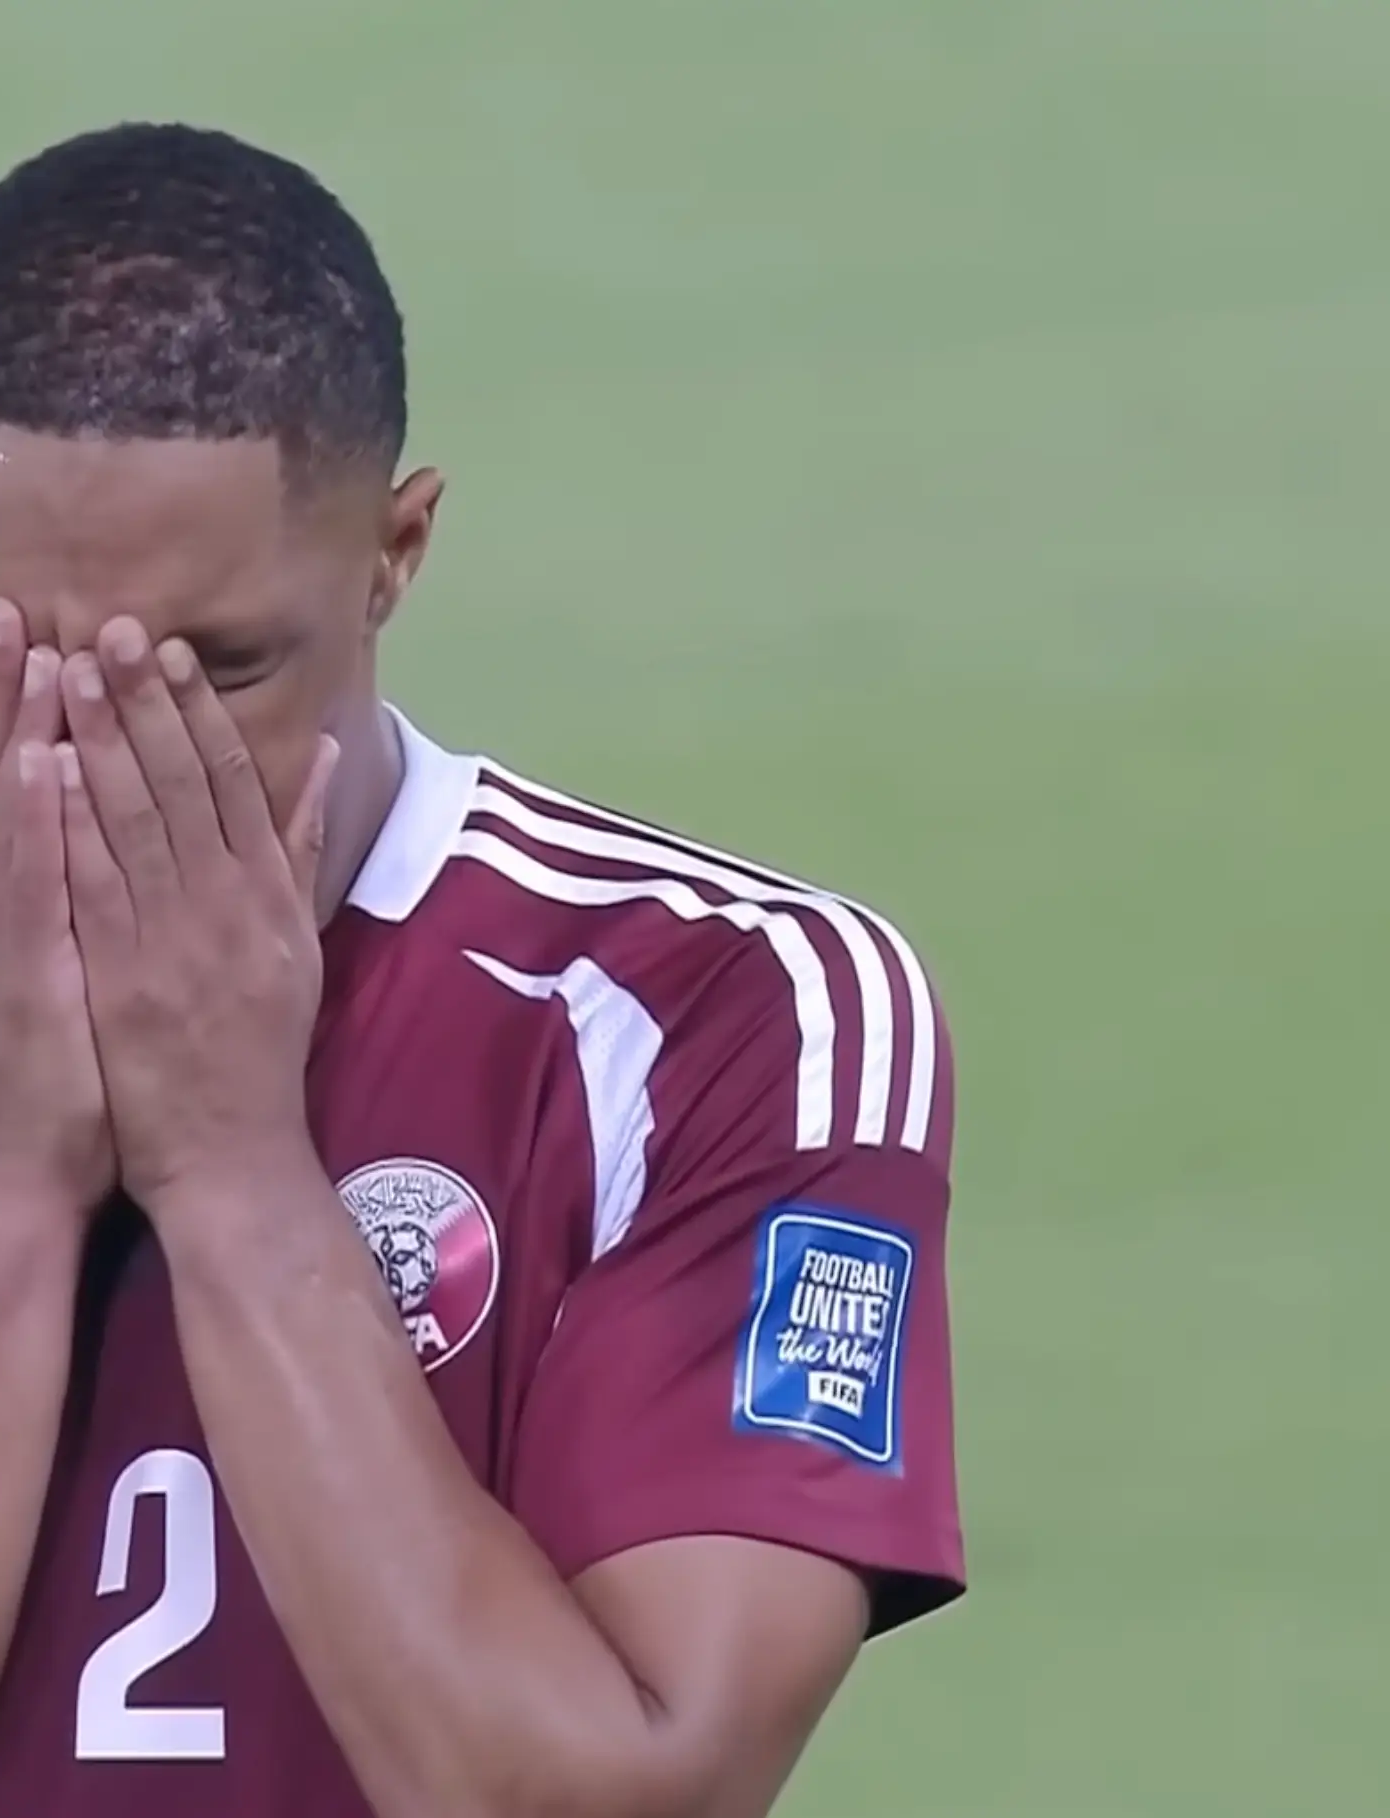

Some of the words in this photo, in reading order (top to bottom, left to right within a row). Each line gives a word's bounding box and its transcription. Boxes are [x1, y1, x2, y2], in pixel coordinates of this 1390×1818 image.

[776, 1327, 823, 1363] the
[818, 1377, 860, 1406] FIFA
[75, 1449, 225, 1760] 2
